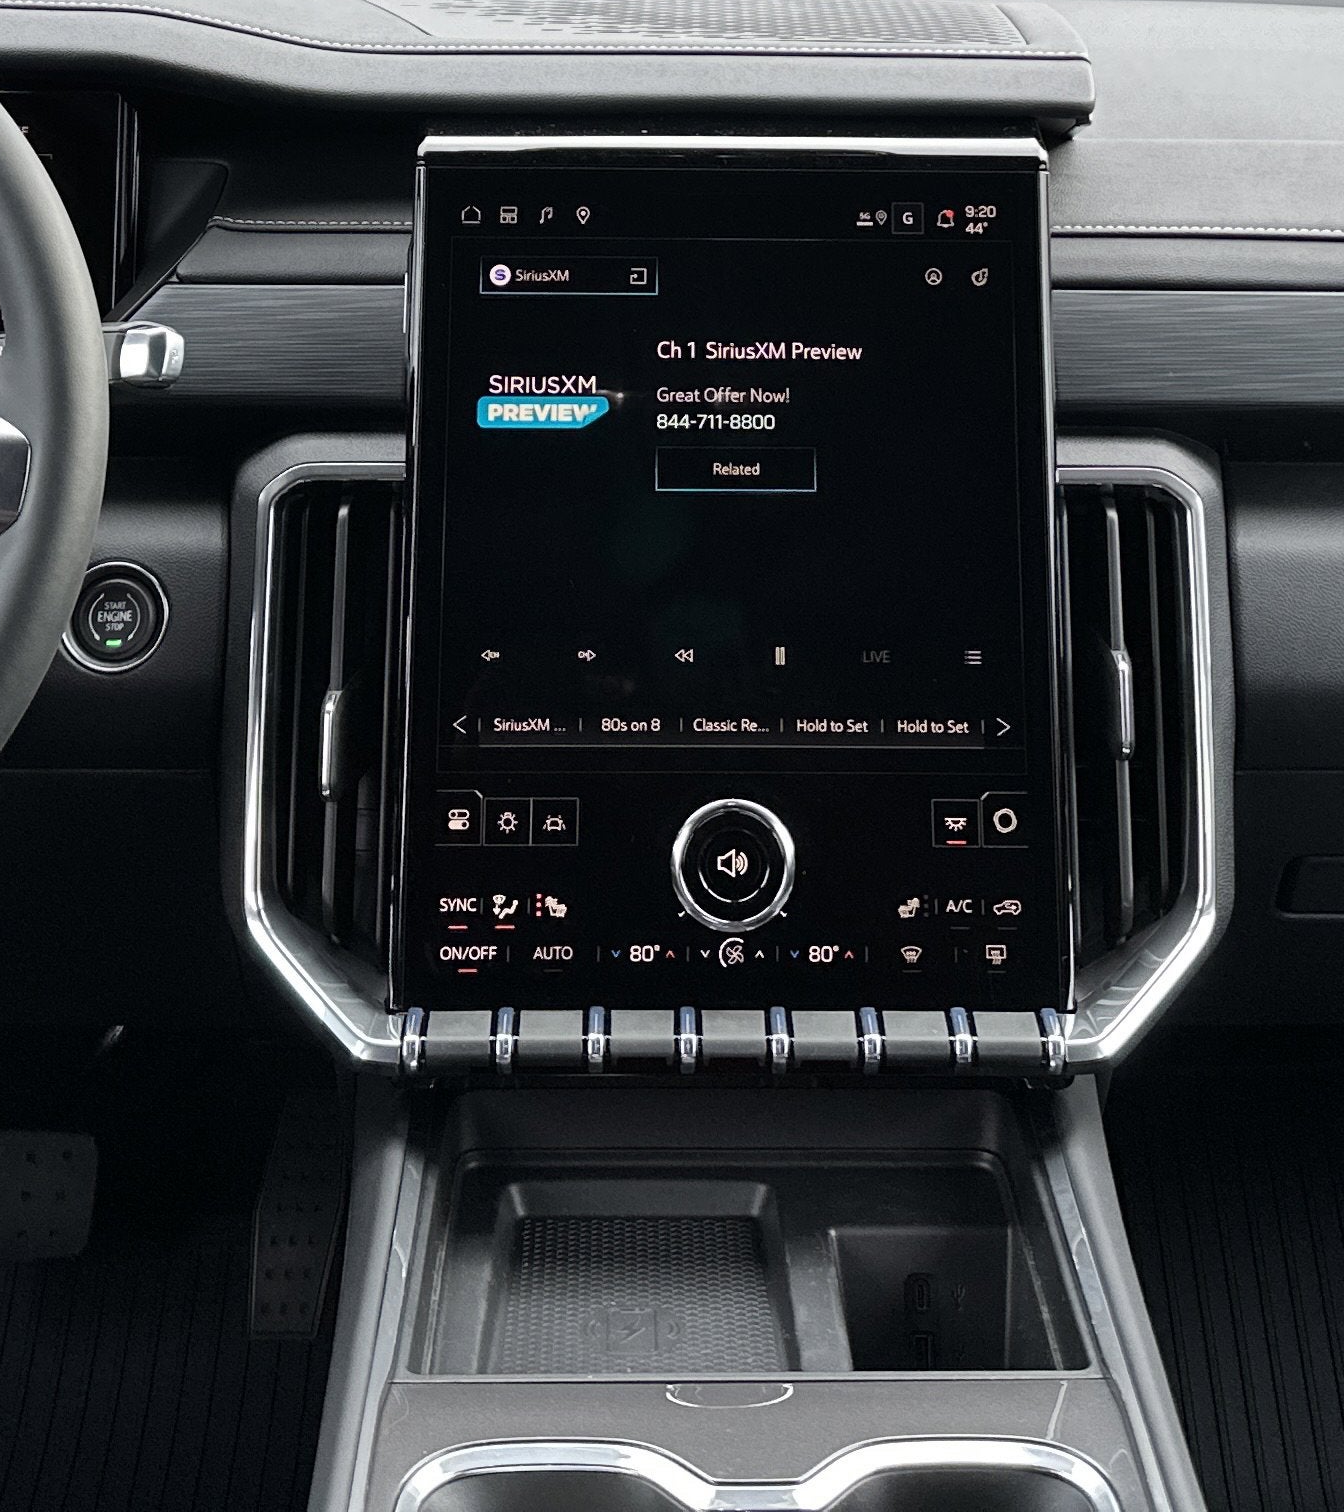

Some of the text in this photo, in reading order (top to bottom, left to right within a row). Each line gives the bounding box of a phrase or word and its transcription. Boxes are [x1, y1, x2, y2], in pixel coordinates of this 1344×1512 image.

[902, 212, 913, 224] G
[965, 205, 996, 218] 9:20
[965, 222, 988, 234] 44°
[515, 269, 570, 281] SiriusXM
[657, 341, 862, 362] Ch 1 SiriusXM Preview
[488, 374, 596, 394] SIRIUSXM
[656, 386, 790, 404] Great Offer Now!
[487, 404, 598, 422] PREVIEW
[656, 414, 776, 431] 844-711-8800
[712, 462, 760, 476] Related
[104, 601, 126, 609] START
[97, 610, 132, 622] ENGINE
[105, 623, 124, 631] STOP
[862, 650, 891, 664] LIVE
[493, 718, 550, 732] SiriusXM
[601, 718, 660, 733] 80s on 8
[693, 718, 734, 734] Classic
[796, 718, 868, 734] Hold to Set
[896, 719, 969, 734] Hold to Set
[439, 898, 477, 913] SYNC
[946, 899, 972, 914] A/C
[439, 946, 497, 962] ON/OFF
[532, 946, 573, 961] AUTO
[629, 944, 660, 962] 80°
[808, 945, 840, 963] 80°
